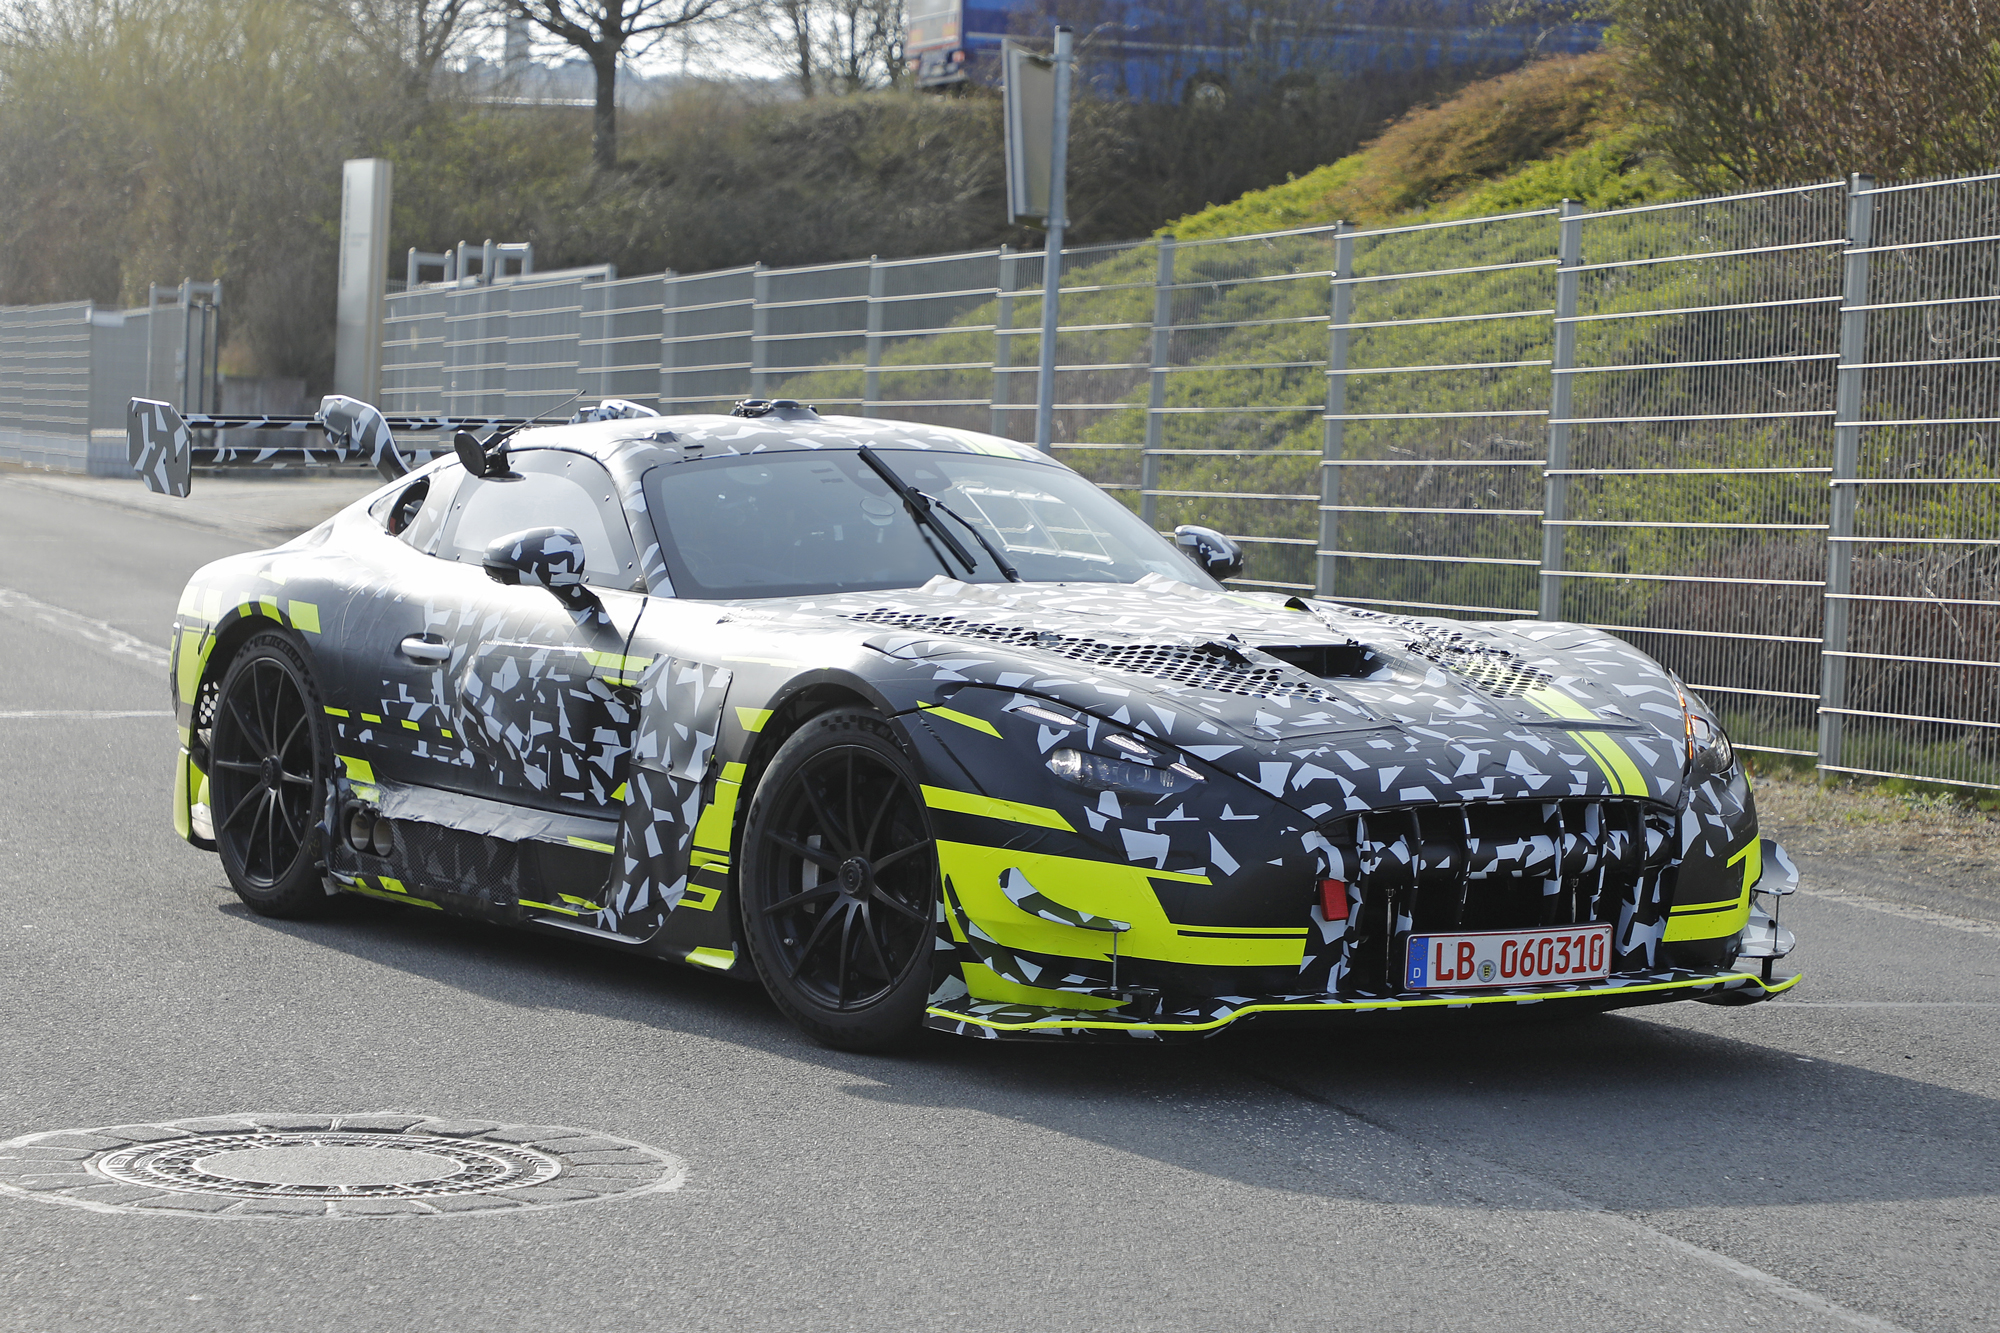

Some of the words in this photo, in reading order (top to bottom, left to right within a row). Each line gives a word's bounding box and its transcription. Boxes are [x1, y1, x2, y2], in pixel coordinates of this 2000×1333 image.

[1436, 941, 1475, 981] LB
[1501, 934, 1604, 978] 060310
[1413, 967, 1422, 979] D
